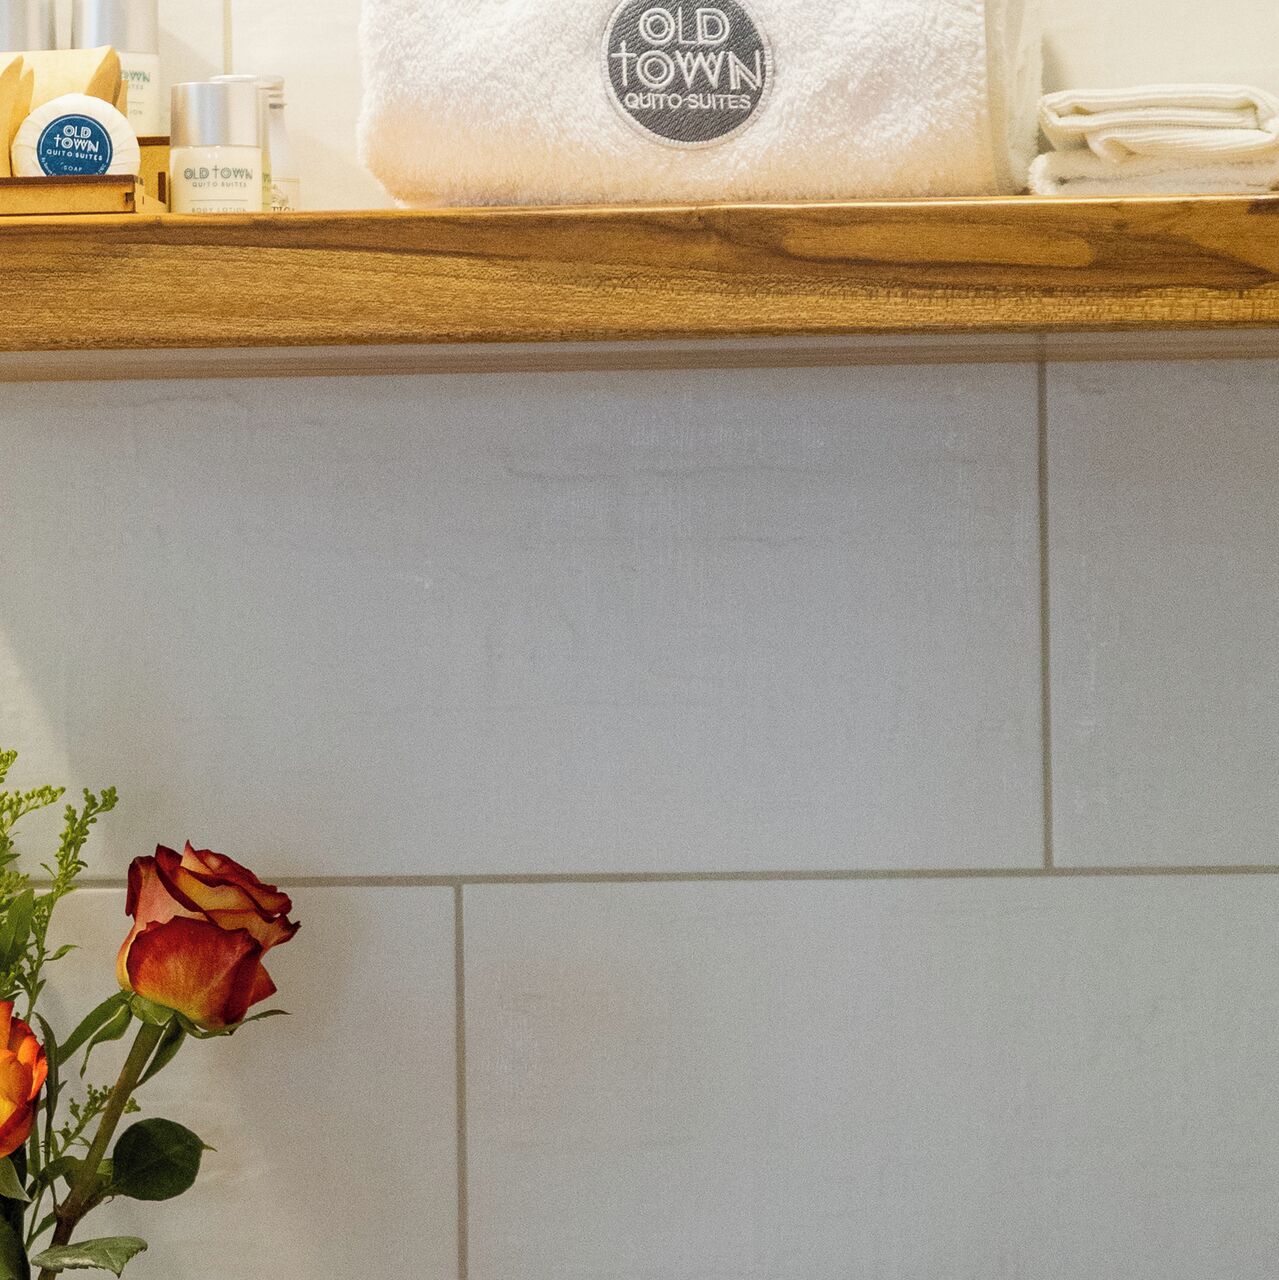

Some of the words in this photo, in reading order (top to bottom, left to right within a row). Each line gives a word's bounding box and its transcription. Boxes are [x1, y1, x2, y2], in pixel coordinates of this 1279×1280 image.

[639, 7, 730, 46] OLD
[625, 92, 683, 110] QUITO
[687, 93, 751, 110] SUITES
[63, 125, 92, 139] OLD
[46, 148, 73, 157] QUITO
[75, 152, 103, 161] SUITES
[184, 167, 209, 180] OLD
